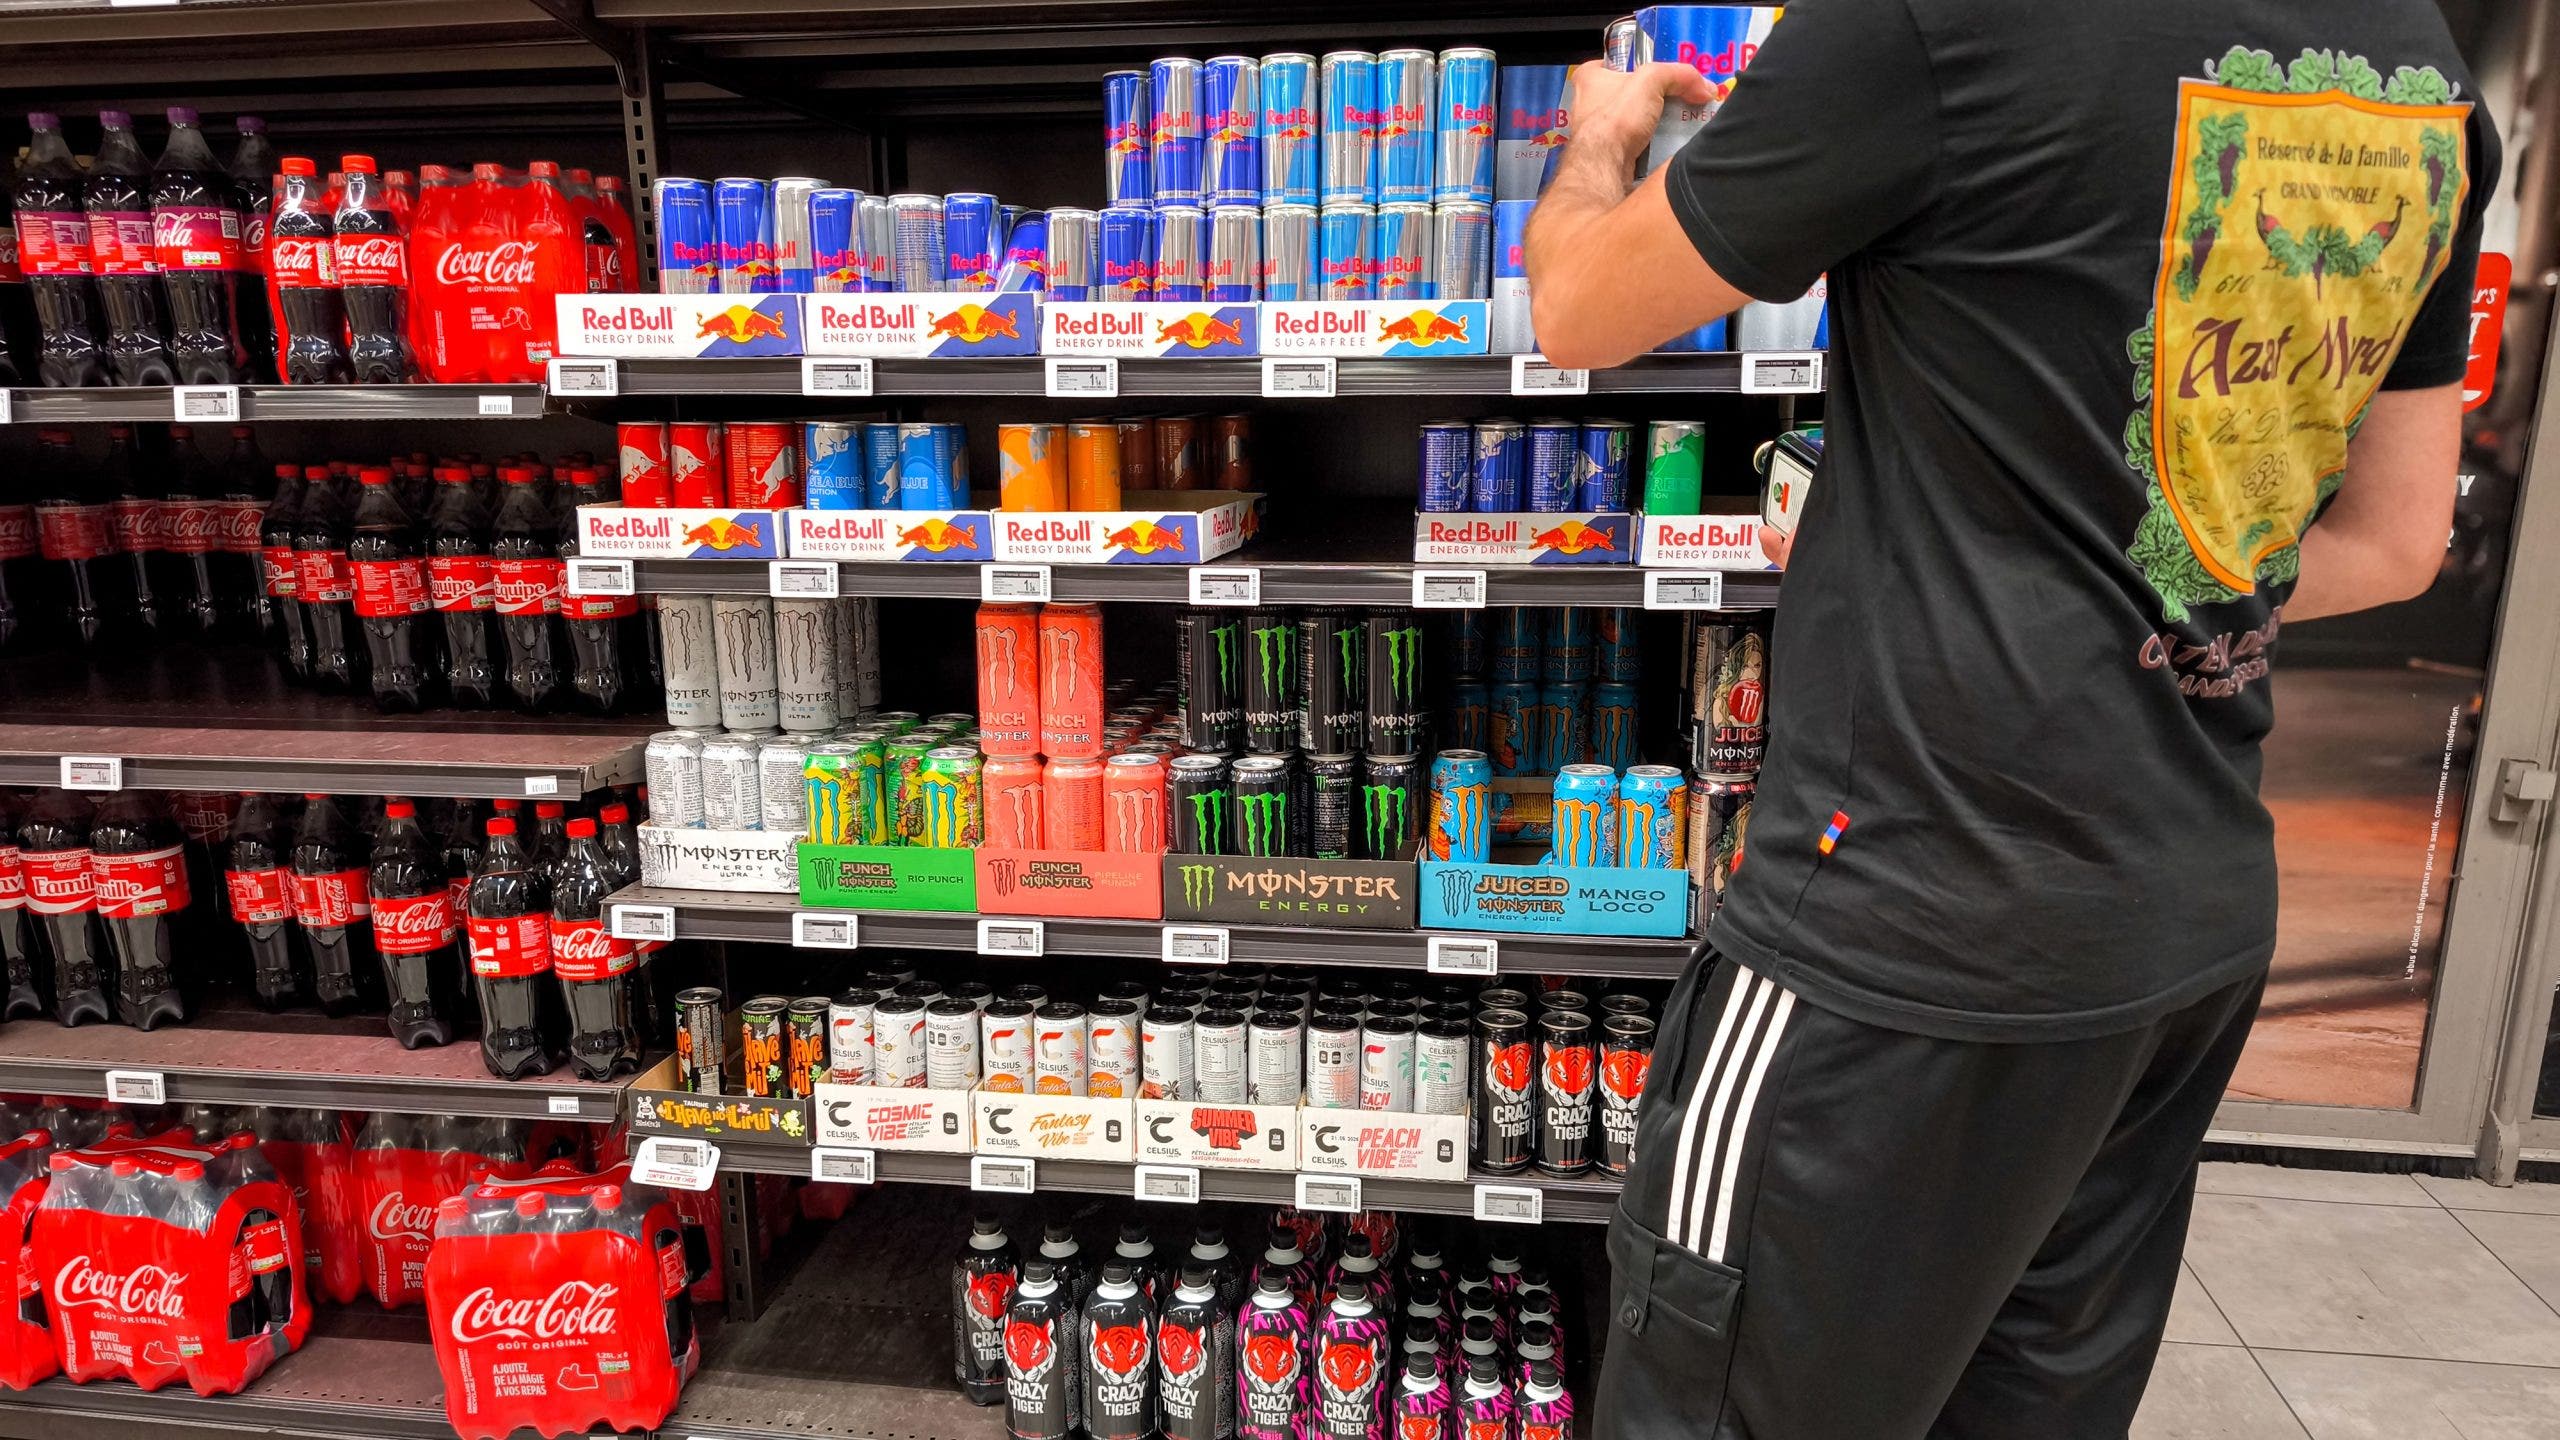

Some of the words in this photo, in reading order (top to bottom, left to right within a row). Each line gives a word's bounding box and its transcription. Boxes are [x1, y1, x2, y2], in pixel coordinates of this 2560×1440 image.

[1394, 105, 1424, 121] Bull
[1454, 104, 1484, 121] Red
[1512, 109, 1550, 128] Red
[2338, 144, 2352, 165] la
[2357, 144, 2410, 169] famille
[2281, 182, 2321, 199] GRAND
[2326, 185, 2379, 204] VIGNOBLE
[720, 241, 752, 260] Red
[436, 242, 540, 285] Coca-Cola
[952, 253, 983, 270] Red
[1107, 260, 1134, 276] Red
[1394, 256, 1422, 272] Bull
[582, 307, 626, 330] Red
[630, 306, 673, 330] Bull
[821, 305, 866, 328] Red
[870, 305, 914, 328] Bull
[1056, 312, 1097, 334] Red
[1102, 312, 1144, 334] Bull
[1276, 311, 1319, 334] Red
[1324, 310, 1366, 333] Bull
[584, 335, 630, 344] ENERGY
[632, 335, 674, 344] DRINK
[823, 333, 872, 343] ENERGY
[878, 333, 916, 343] DRINK
[1056, 338, 1102, 348] ENERGY
[1108, 338, 1144, 348] DRINK
[1275, 338, 1366, 347] SUGARFREE
[810, 476, 834, 487] SEA
[836, 476, 864, 489] BLU
[590, 517, 628, 537] Red
[632, 517, 670, 537] Bull
[801, 519, 841, 539] Red
[845, 518, 883, 538] Bull
[1007, 521, 1047, 542] Red
[1051, 520, 1090, 541] Bull
[1430, 521, 1472, 542] Red
[1476, 521, 1517, 542] Bull
[1658, 524, 1704, 546] Red
[1708, 524, 1751, 546] Bull
[592, 540, 635, 550] ENERGY
[638, 540, 672, 550] DRINK
[802, 542, 846, 551] ENERGY
[851, 542, 884, 551] DRINK
[1008, 545, 1052, 554] ENERGY
[1057, 545, 1092, 554] DRINK
[1430, 546, 1477, 554] ENERGY
[1481, 546, 1516, 554] DRINK
[1657, 550, 1707, 559] ENERGY
[1712, 550, 1751, 559] DRINK
[1715, 725, 1763, 742] JUICE
[2446, 704, 2460, 751] modération.
[1710, 746, 1761, 760] MONST
[2442, 752, 2451, 770] avec
[2435, 772, 2448, 818] consommez
[683, 846, 783, 862] MONSTER
[2426, 852, 2434, 871] pour
[841, 863, 891, 875] PUNCH
[1031, 862, 1080, 873] PUNCH
[1096, 871, 1142, 880] PIPELINE
[33, 875, 95, 896] Famil
[838, 876, 897, 888] MONSTER
[908, 875, 925, 883] RIO
[928, 876, 964, 884] PUNCH
[1021, 875, 1092, 888] MONSTER
[1101, 879, 1136, 887] PUNCH
[1227, 869, 1400, 900] MONSTER
[1474, 875, 1570, 897] JUICED
[97, 880, 142, 899] mille
[1579, 889, 1666, 900] MANGO
[2418, 872, 2430, 912] dangereux
[1260, 901, 1369, 913] ENERGY
[1477, 897, 1565, 914] MONSTER
[1589, 902, 1654, 914] LOCO
[397, 936, 432, 944] ORIGINAL
[2409, 925, 2421, 954] d'alcool
[2404, 955, 2416, 980] L'abus
[1202, 1036, 1228, 1044] CELSIUS
[989, 1060, 1021, 1069] CELSIUS
[1038, 1062, 1069, 1071] CELSIUS
[1090, 1058, 1120, 1067] CELSIUS
[683, 1100, 709, 1108] TAURINE
[713, 1111, 725, 1120] NO
[867, 1103, 933, 1124] COSMIC
[1191, 1108, 1257, 1134] SUMMER
[1548, 1104, 1593, 1126] CRAZY
[1029, 1113, 1091, 1132] Fantasy
[1499, 1123, 1530, 1138] TIGER
[826, 1130, 856, 1138] CELSIUS
[868, 1124, 908, 1141] VIBE
[1038, 1132, 1070, 1148] Vibe
[1209, 1128, 1241, 1150] VIBE
[1359, 1128, 1421, 1148] PEACH
[1553, 1125, 1588, 1140] TIGER
[986, 1138, 1019, 1146] CELSIUS
[1147, 1147, 1180, 1155] CELSIUS
[1358, 1149, 1399, 1168] VIBE
[1312, 1156, 1344, 1164] CELSIUS
[406, 1243, 429, 1252] GOÛT
[54, 1256, 188, 1318] Coca-Cola
[94, 1312, 116, 1321] GOÛT
[120, 1316, 167, 1326] ORIGINAL
[452, 1280, 618, 1342] Coca-Cola
[90, 1330, 120, 1342] AJOUTEZ
[497, 1341, 527, 1350] GOÛT
[533, 1338, 589, 1350] ORIGINAL
[92, 1342, 101, 1351] DE
[102, 1342, 110, 1353] LA
[100, 1352, 116, 1363] VOS
[493, 1362, 528, 1374] AJOUTEZ
[494, 1375, 505, 1385] DE
[507, 1375, 518, 1385] LA
[519, 1374, 545, 1384] MAGIE
[503, 1386, 520, 1396] VOS
[521, 1385, 547, 1395] REPAS
[1007, 1380, 1048, 1400] CRAZY
[1098, 1382, 1146, 1402] CRAZY
[1159, 1385, 1200, 1405] CRAZY
[1012, 1400, 1045, 1414] TIGER
[1103, 1402, 1140, 1416] TIGER
[1163, 1399, 1194, 1419] TIGER
[1248, 1393, 1295, 1411] CRAZY
[1254, 1411, 1288, 1425] TIGER
[1323, 1400, 1370, 1421] CRAZY
[1329, 1421, 1364, 1436] TIGER
